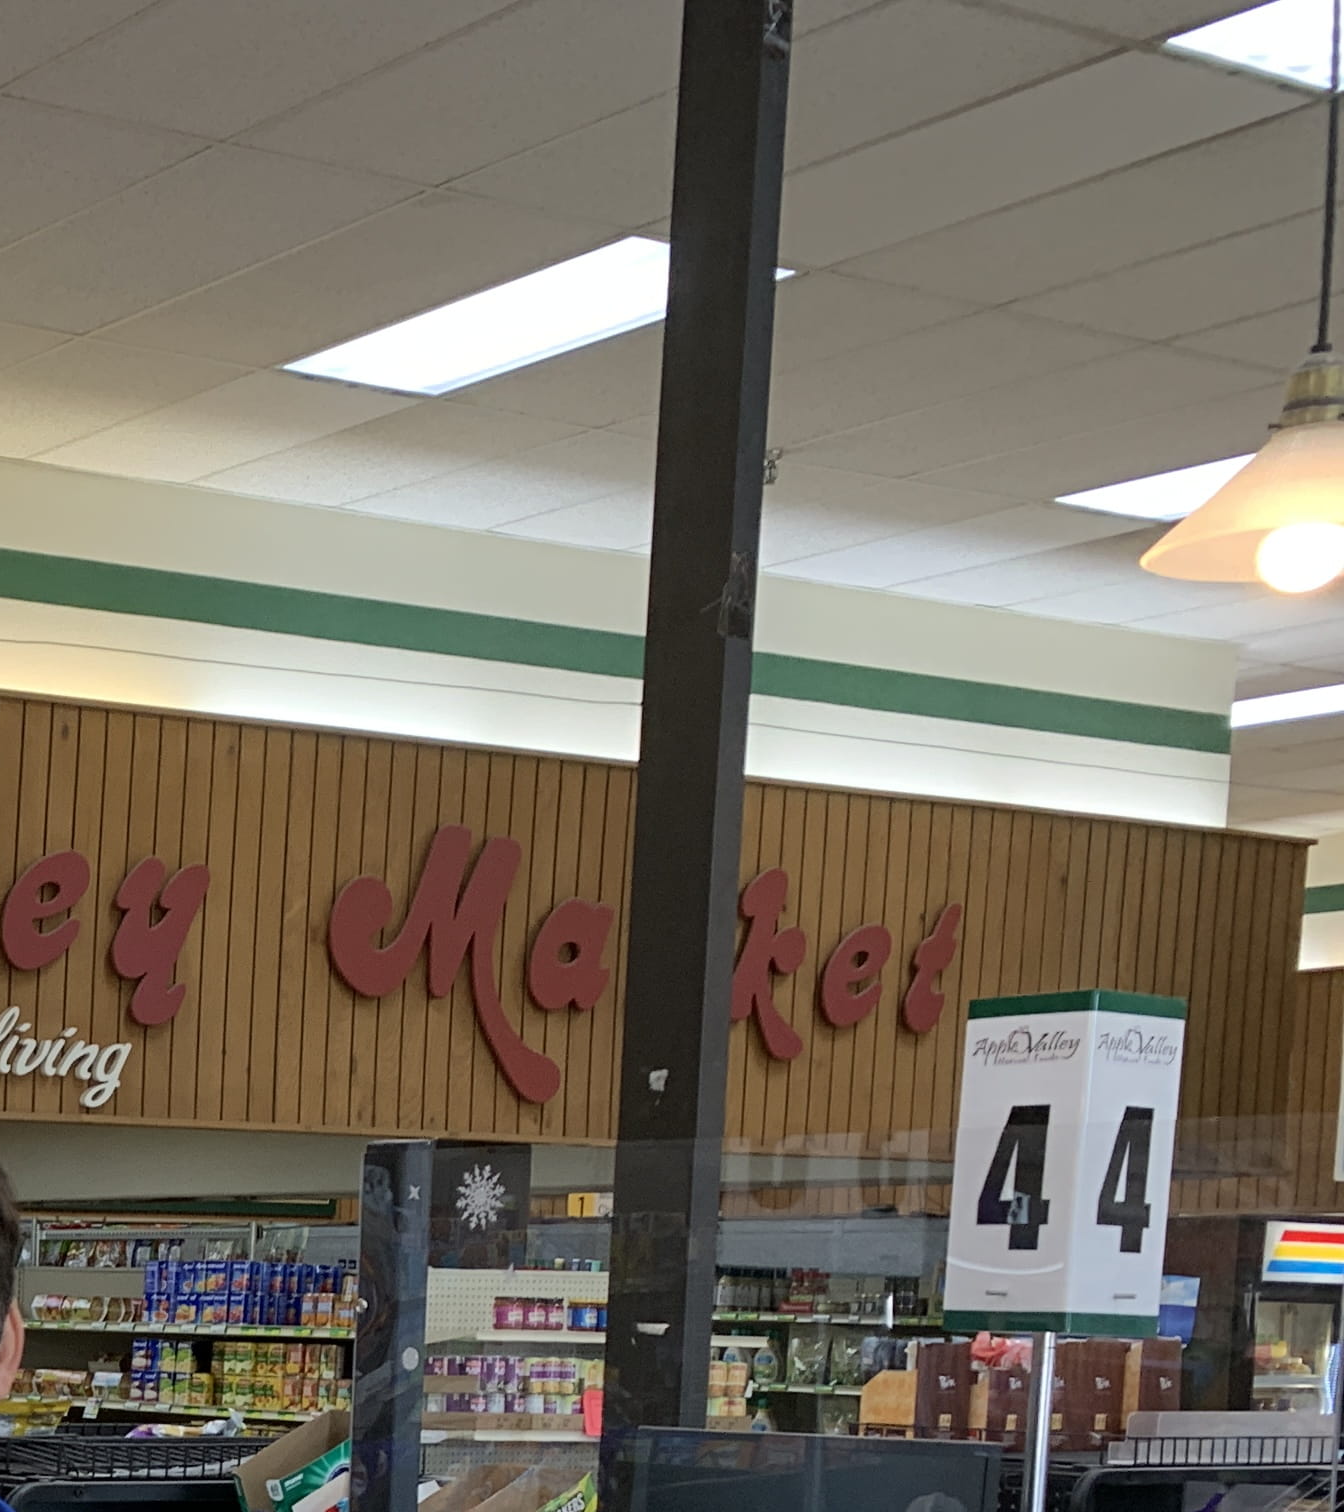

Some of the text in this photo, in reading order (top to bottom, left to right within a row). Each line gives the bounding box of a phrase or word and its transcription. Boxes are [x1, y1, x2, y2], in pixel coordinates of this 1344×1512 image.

[329, 825, 964, 1103] Maket
[973, 1031, 1080, 1066] Apple Valley
[1136, 1032, 1178, 1065] Valley
[976, 1104, 1051, 1250] 4
[1096, 1106, 1155, 1253] 4
